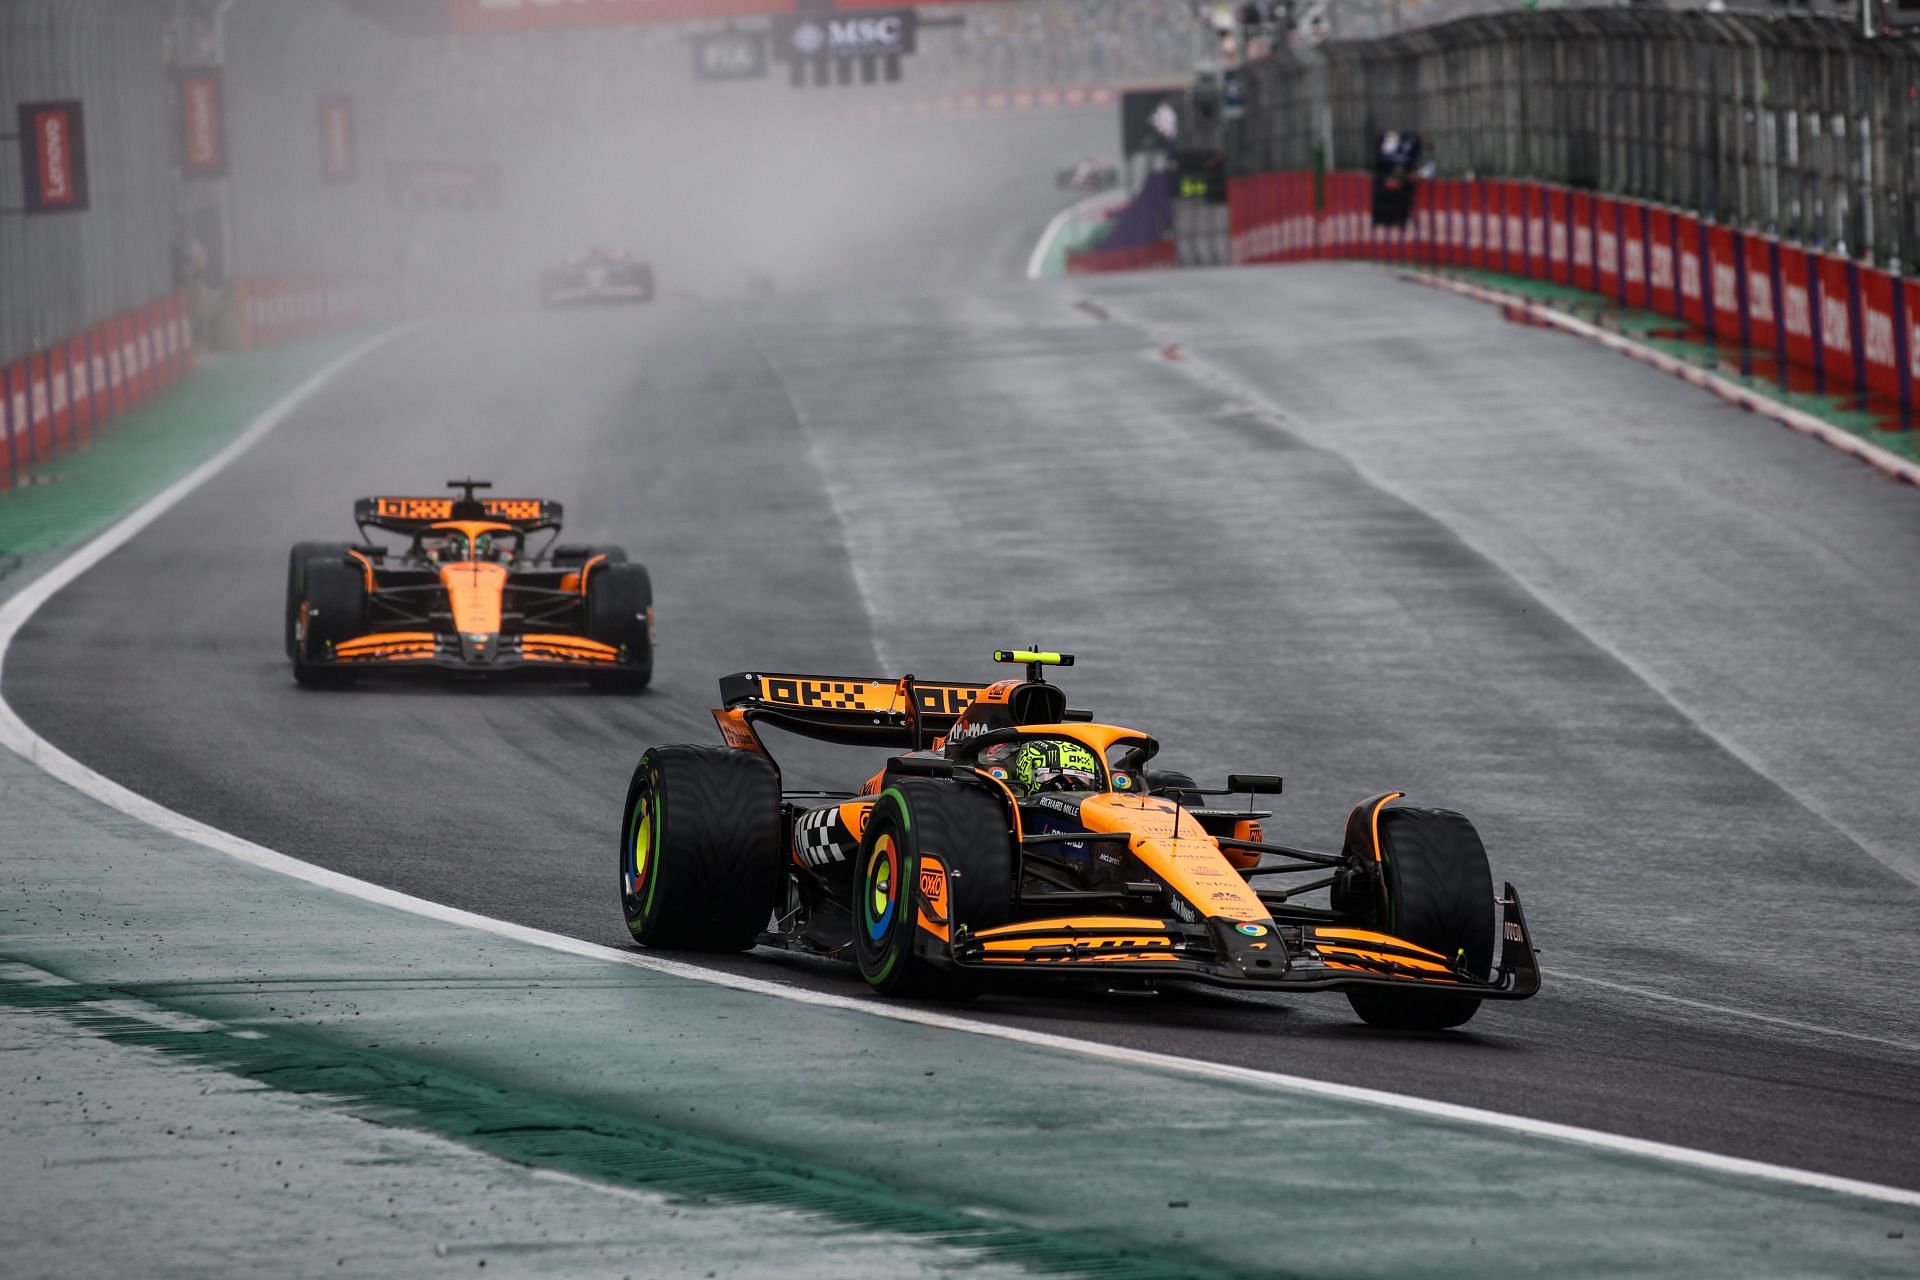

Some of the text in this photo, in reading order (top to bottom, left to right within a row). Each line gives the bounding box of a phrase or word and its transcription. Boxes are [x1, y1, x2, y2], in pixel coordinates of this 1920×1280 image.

[829, 17, 900, 46] MSC
[45, 118, 66, 198] Lenovo
[769, 680, 865, 710] OKX
[1069, 755, 1090, 766] OKX
[1040, 797, 1080, 817] RICHARD MILLE
[1099, 853, 1120, 865] McLaren
[920, 873, 943, 897] OXXO
